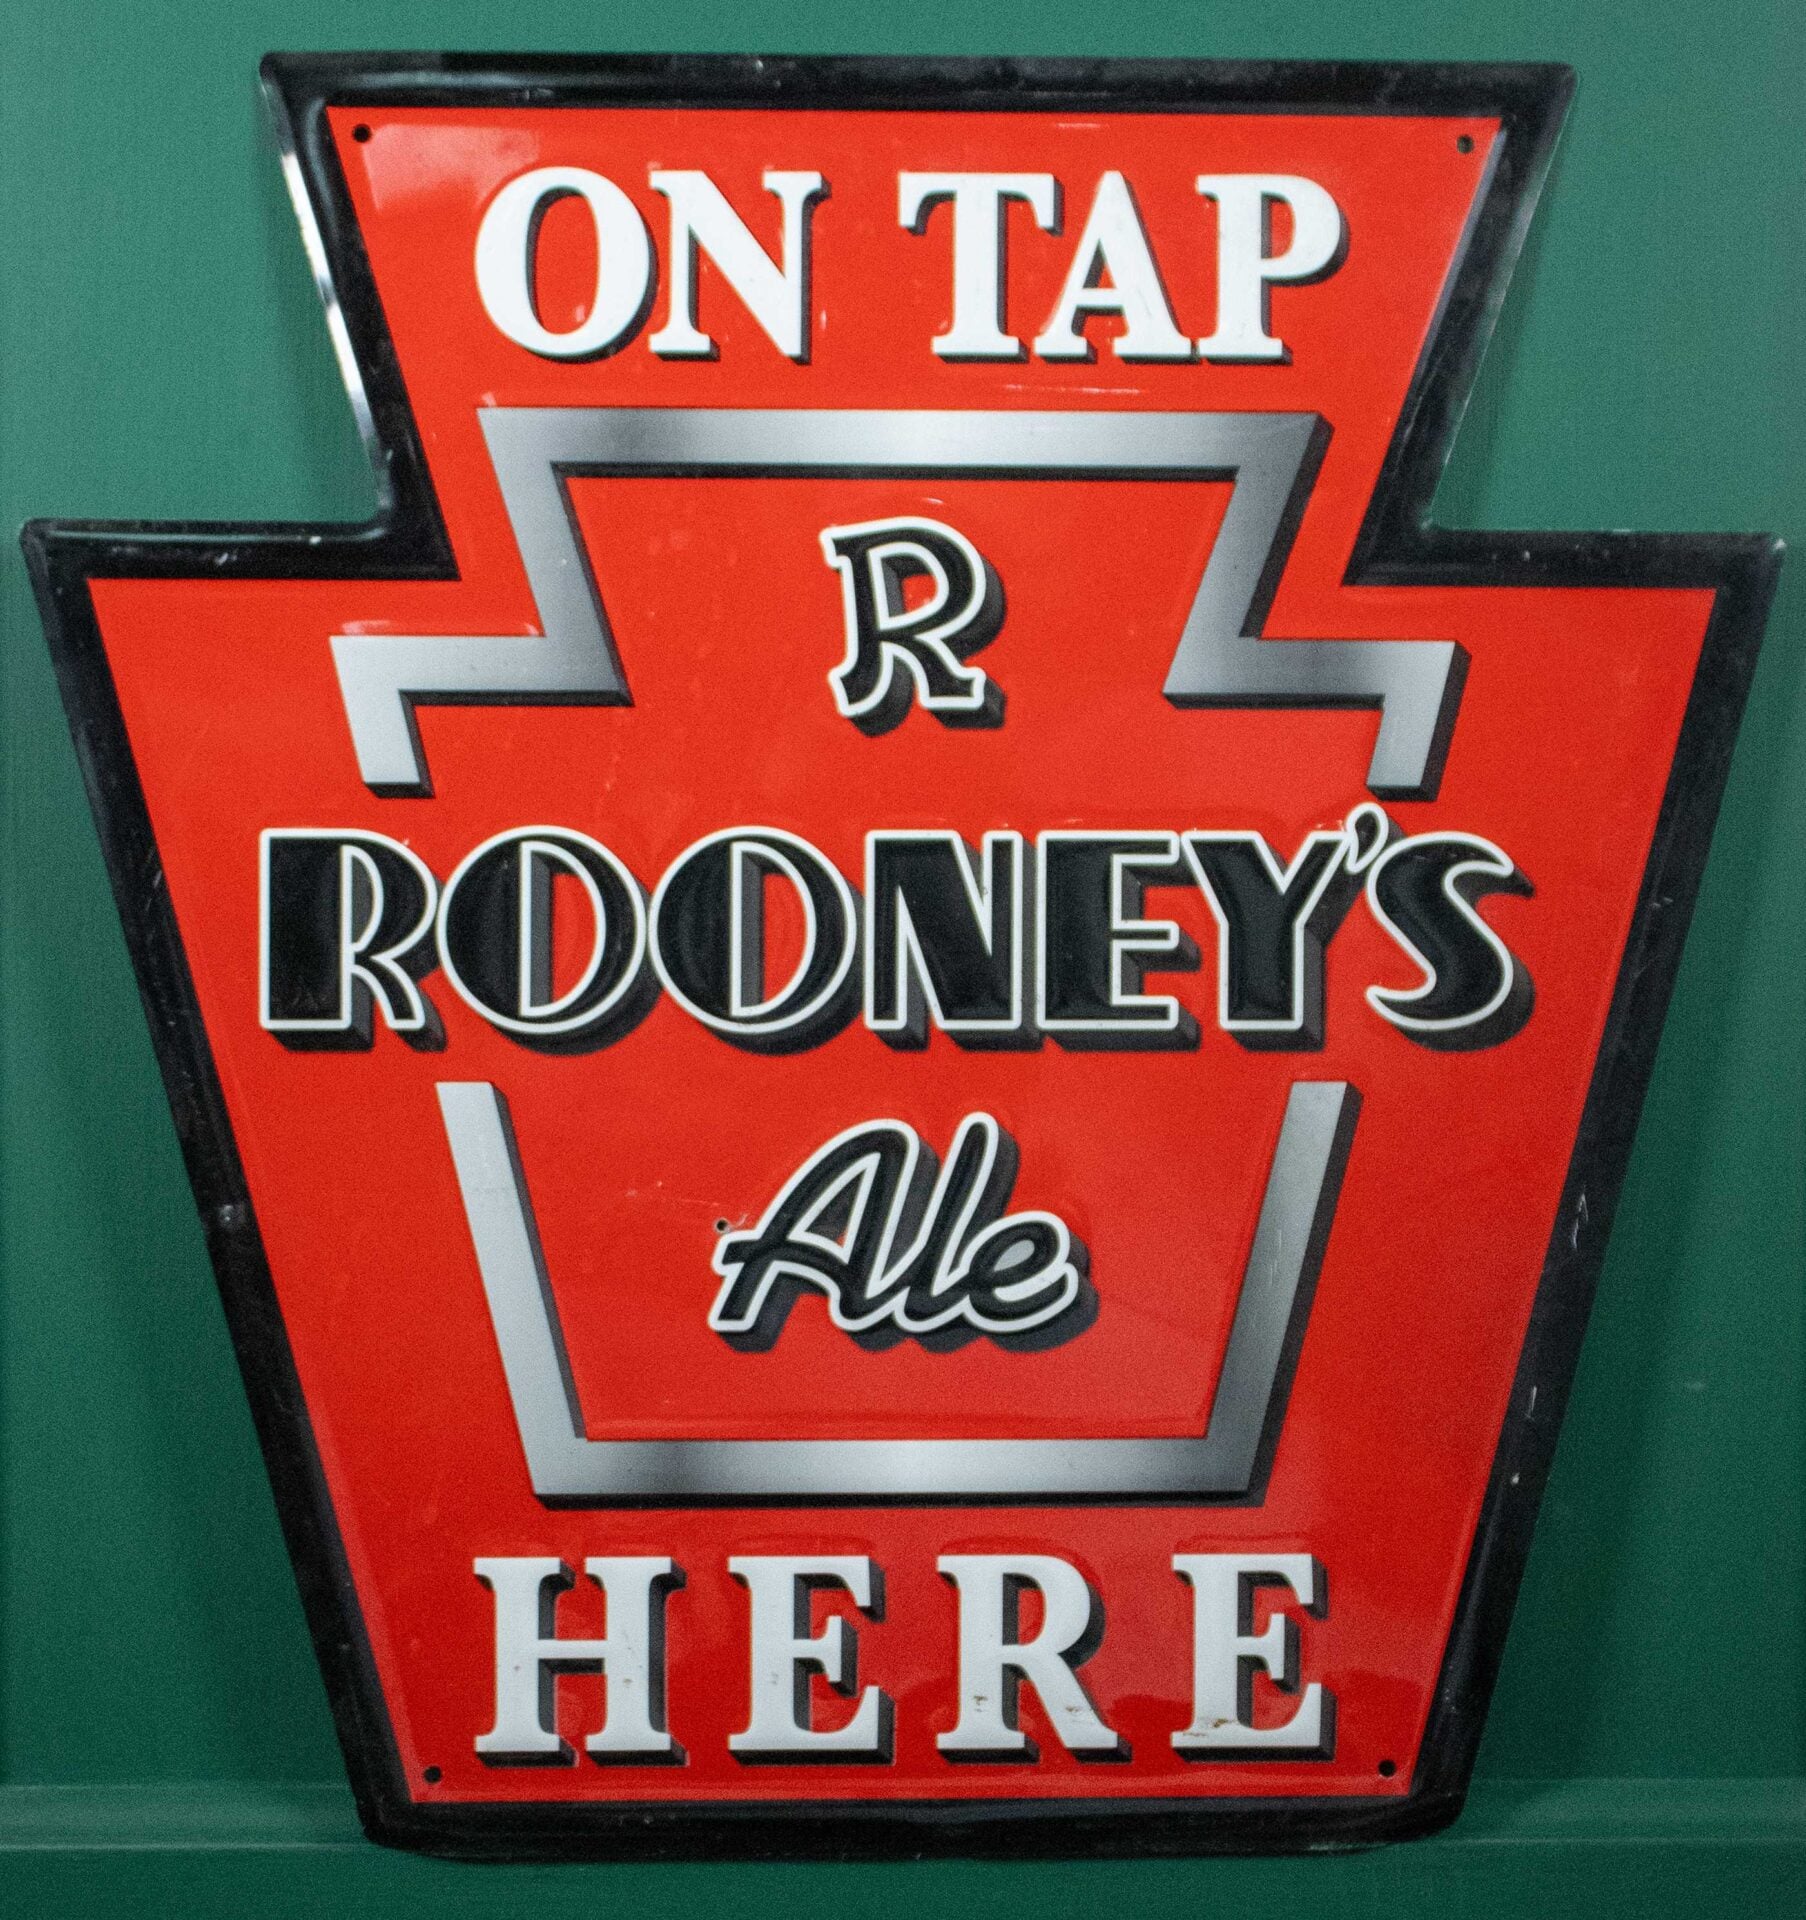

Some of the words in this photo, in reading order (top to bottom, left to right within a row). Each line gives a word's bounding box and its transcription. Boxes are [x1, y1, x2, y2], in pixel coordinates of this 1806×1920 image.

[474, 167, 824, 360] ON
[898, 170, 1346, 361] TAP
[818, 516, 1004, 730] R
[258, 803, 1532, 1048] ROONEY'S
[708, 1112, 1092, 1350] Ale
[473, 1553, 1330, 1765] HERE
